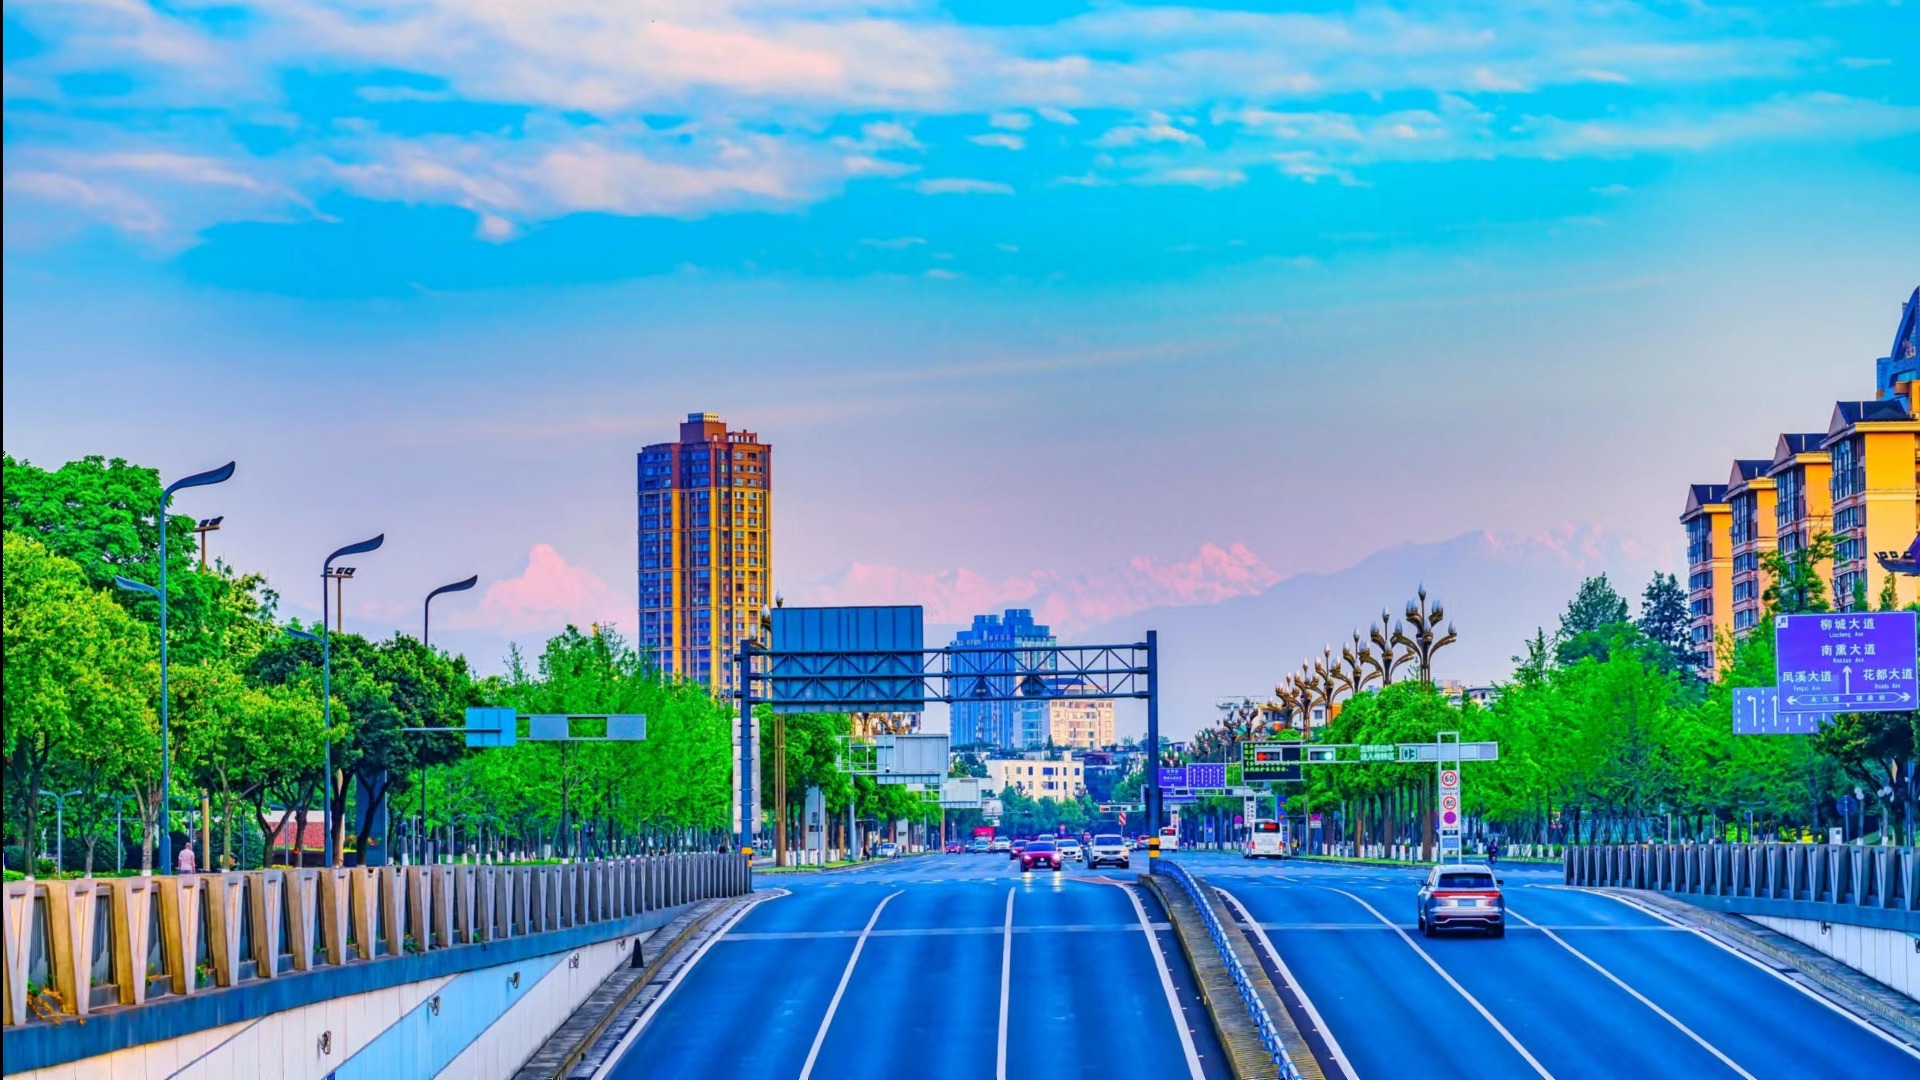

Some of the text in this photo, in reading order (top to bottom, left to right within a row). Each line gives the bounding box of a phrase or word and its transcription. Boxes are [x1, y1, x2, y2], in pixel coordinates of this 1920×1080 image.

[1820, 618, 1875, 630] 柳城大道
[1821, 644, 1876, 656] 南熏大道
[1782, 671, 1832, 682] 凤溪大道
[1863, 668, 1913, 680] 花都大道
[1444, 774, 1454, 783] 60
[1445, 799, 1454, 807] 80
